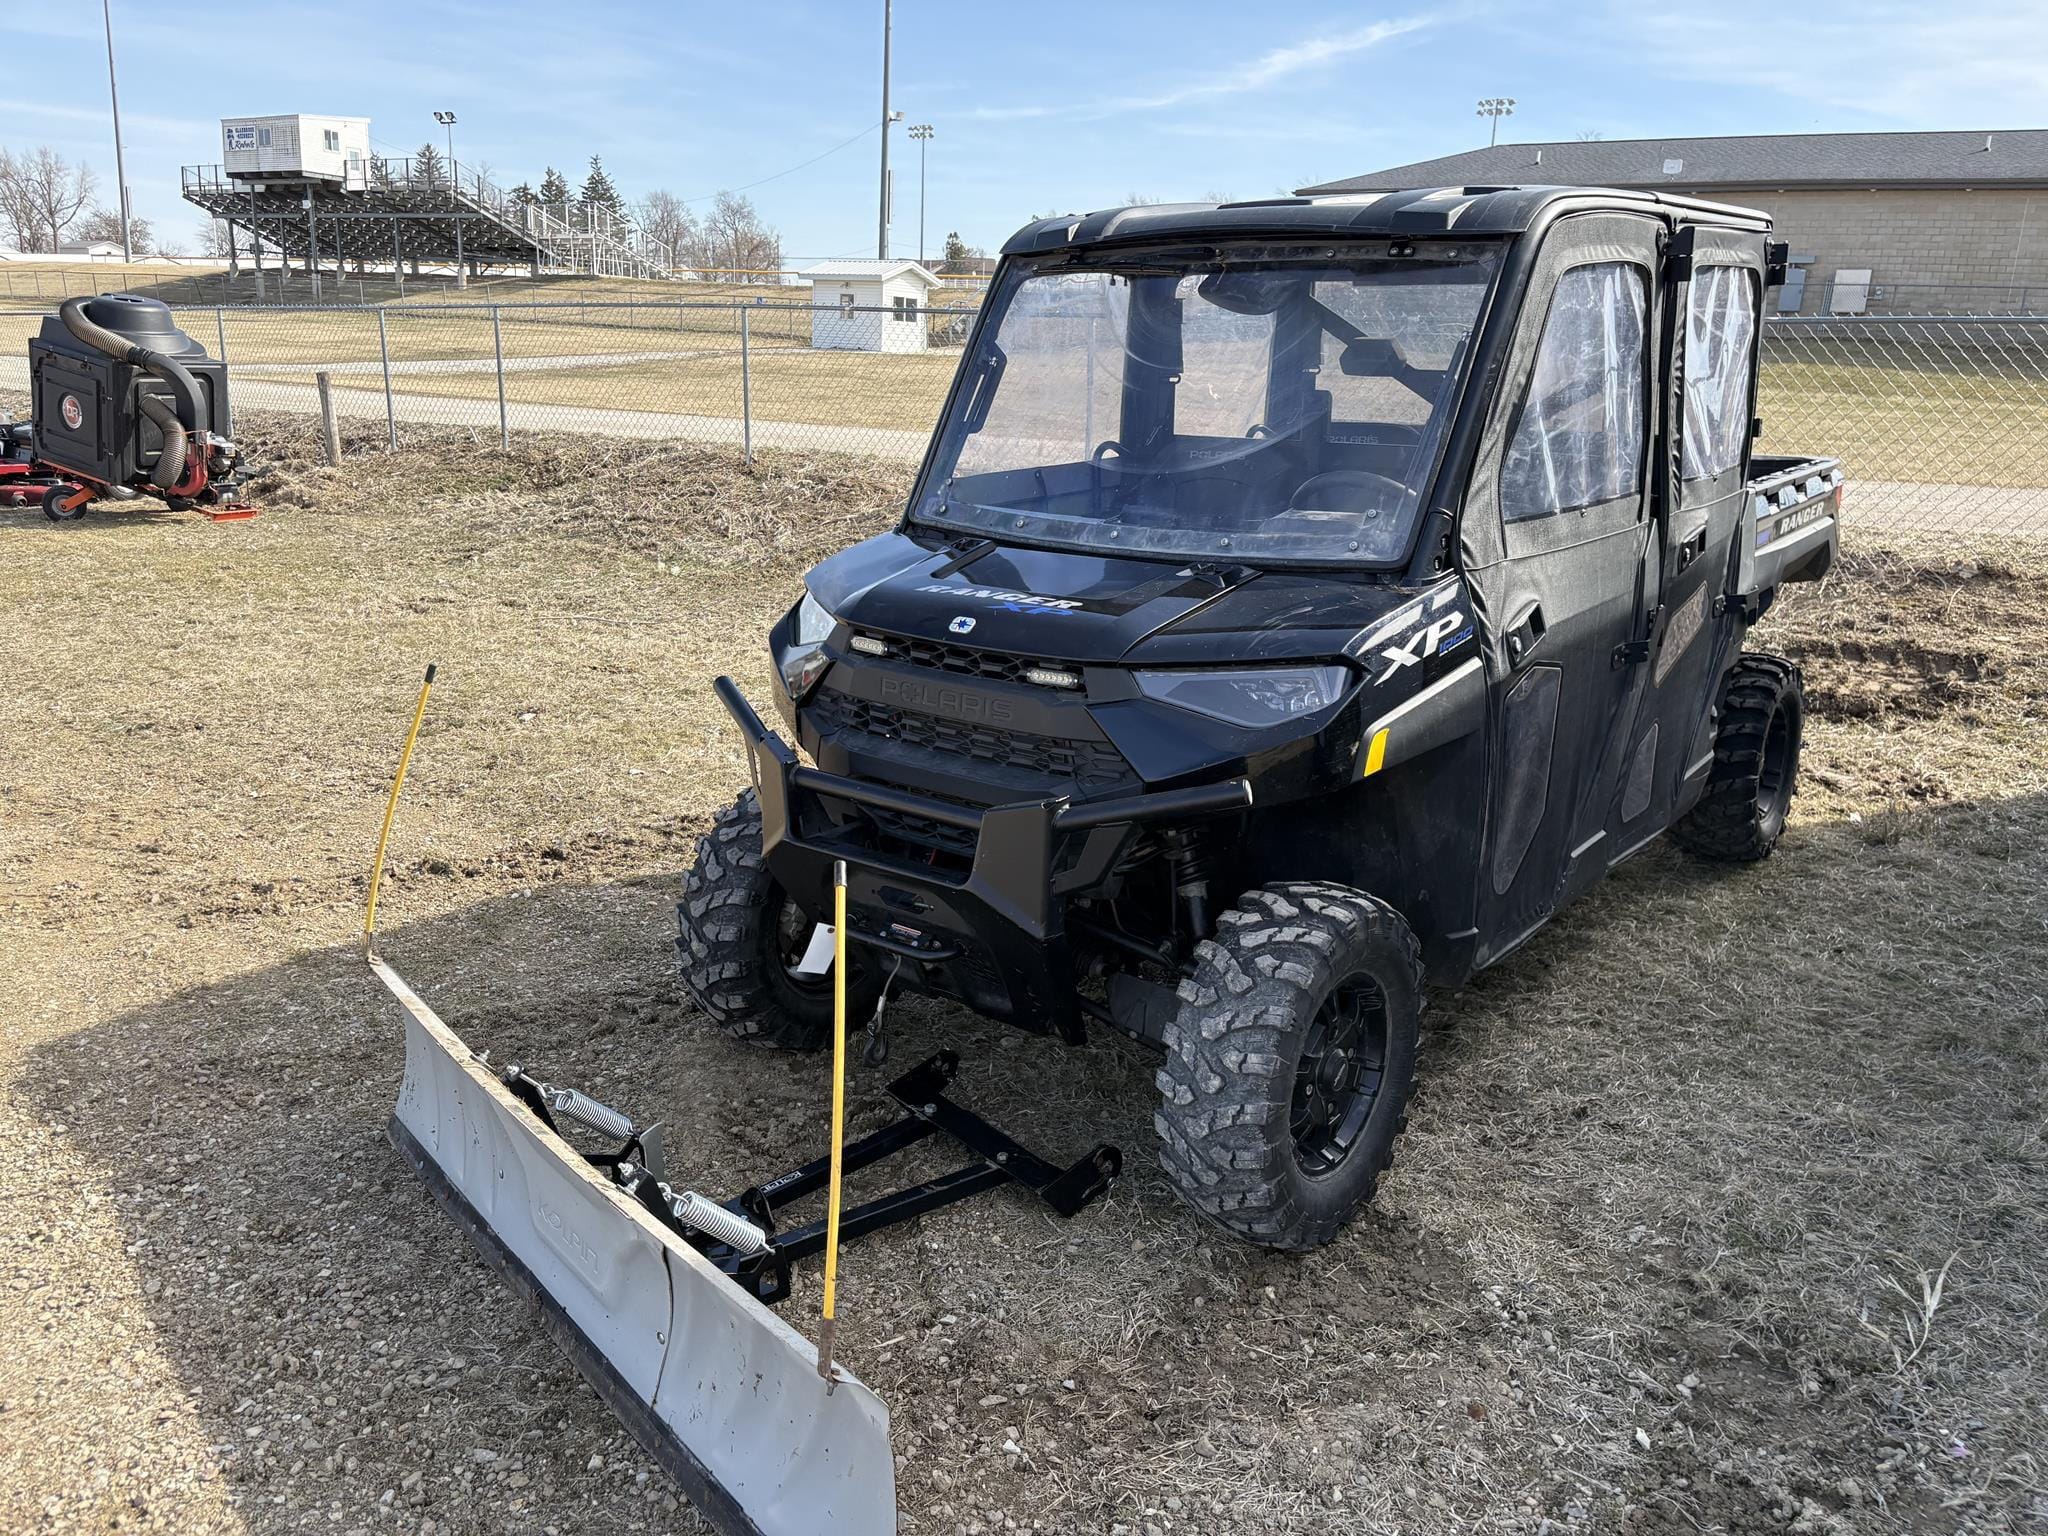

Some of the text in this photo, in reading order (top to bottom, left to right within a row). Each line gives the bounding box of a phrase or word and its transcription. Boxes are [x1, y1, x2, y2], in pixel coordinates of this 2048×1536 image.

[1780, 501, 1825, 535] RANGER
[915, 584, 1084, 609] RANGER
[984, 601, 1074, 616] XP
[1373, 610, 1464, 687] XP
[1439, 625, 1474, 654] 1000
[880, 677, 1013, 721] POLARIS
